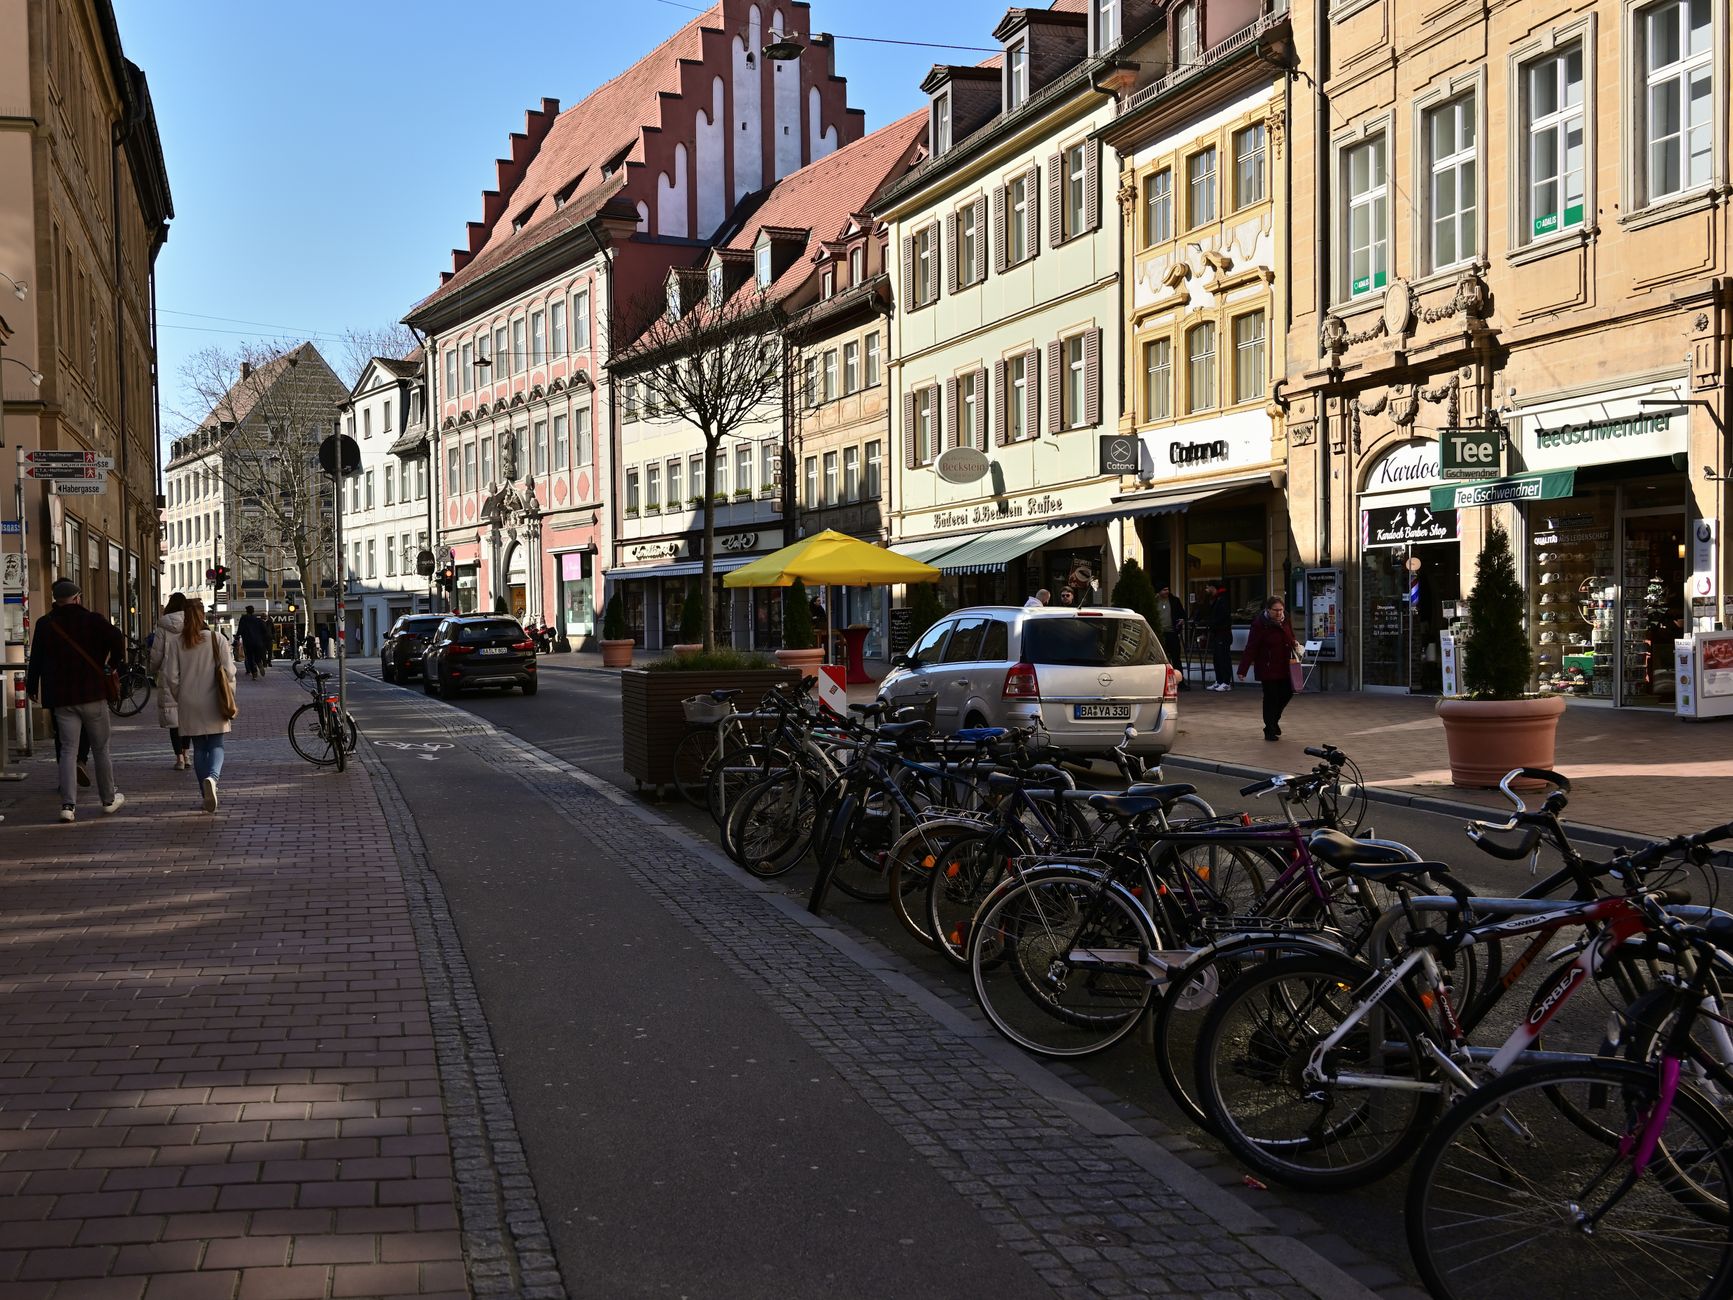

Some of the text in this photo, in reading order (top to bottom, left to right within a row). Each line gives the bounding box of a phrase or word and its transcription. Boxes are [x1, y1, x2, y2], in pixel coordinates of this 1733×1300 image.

[1534, 411, 1672, 449] TeeGschwendner
[1169, 440, 1225, 464] Catana
[1451, 437, 1493, 463] Tee
[942, 462, 986, 472] Beckstein
[1106, 461, 1135, 470] Catana
[1381, 454, 1440, 484] Kardoc
[1446, 469, 1498, 478] Gschwendner
[773, 445, 784, 512] HOTEL
[62, 485, 99, 494] Habergasse
[1457, 482, 1539, 504] Tee Gschwendner
[1027, 495, 1063, 515] Kaffee
[1376, 523, 1447, 540] Kardoch Barber Shop
[1081, 706, 1129, 716] BA YA 330
[1506, 915, 1546, 928] ORBEA
[1530, 968, 1583, 1024] ORBEA
